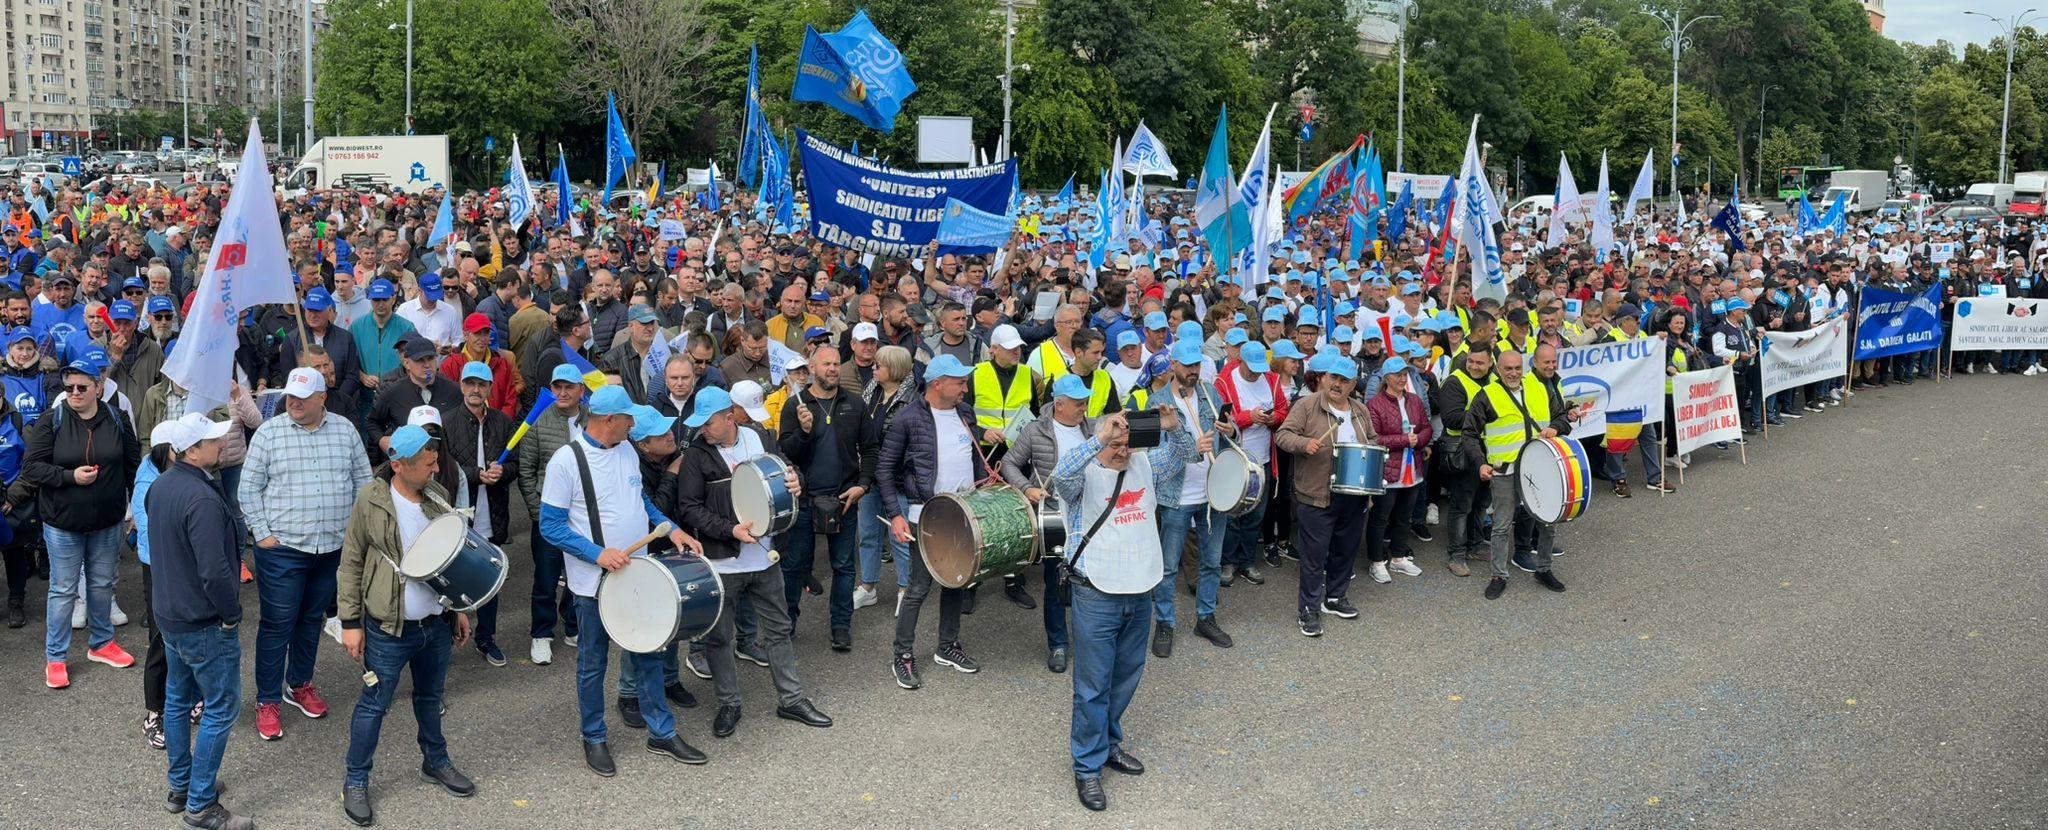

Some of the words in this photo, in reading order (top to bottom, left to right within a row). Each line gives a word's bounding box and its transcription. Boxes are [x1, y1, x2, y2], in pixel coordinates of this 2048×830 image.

[941, 171, 955, 180] DIN
[836, 189, 912, 222] SINDICATUL
[915, 207, 944, 223] LIBE
[871, 219, 905, 241] S.D.
[1774, 291, 1789, 305] BNS
[1711, 302, 1725, 311] BNS
[1906, 330, 1932, 343] GALATI
[1529, 340, 1652, 371] DICATUL
[1677, 405, 1694, 422] LIBER
[1721, 414, 1737, 428] DEJ
[1113, 512, 1147, 526] FNFMC
